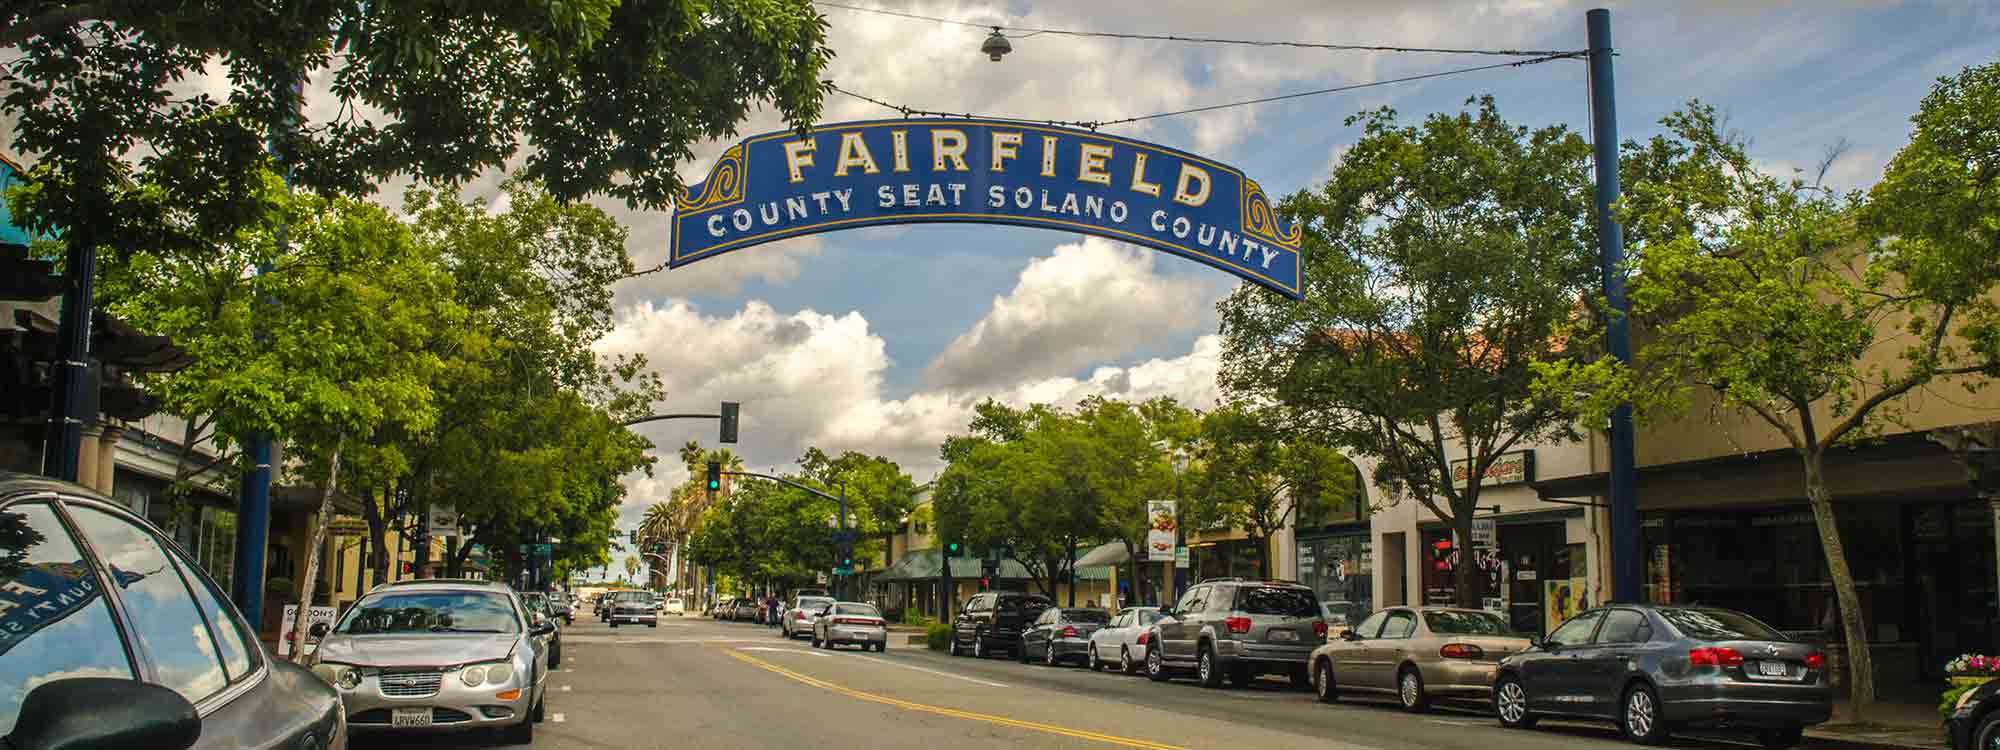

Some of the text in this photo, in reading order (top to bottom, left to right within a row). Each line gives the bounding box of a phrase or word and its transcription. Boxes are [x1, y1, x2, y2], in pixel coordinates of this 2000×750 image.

[783, 128, 1212, 207] FAIRFIELD
[706, 183, 1280, 269] COUNTY SEAT SOLANO COUNTY
